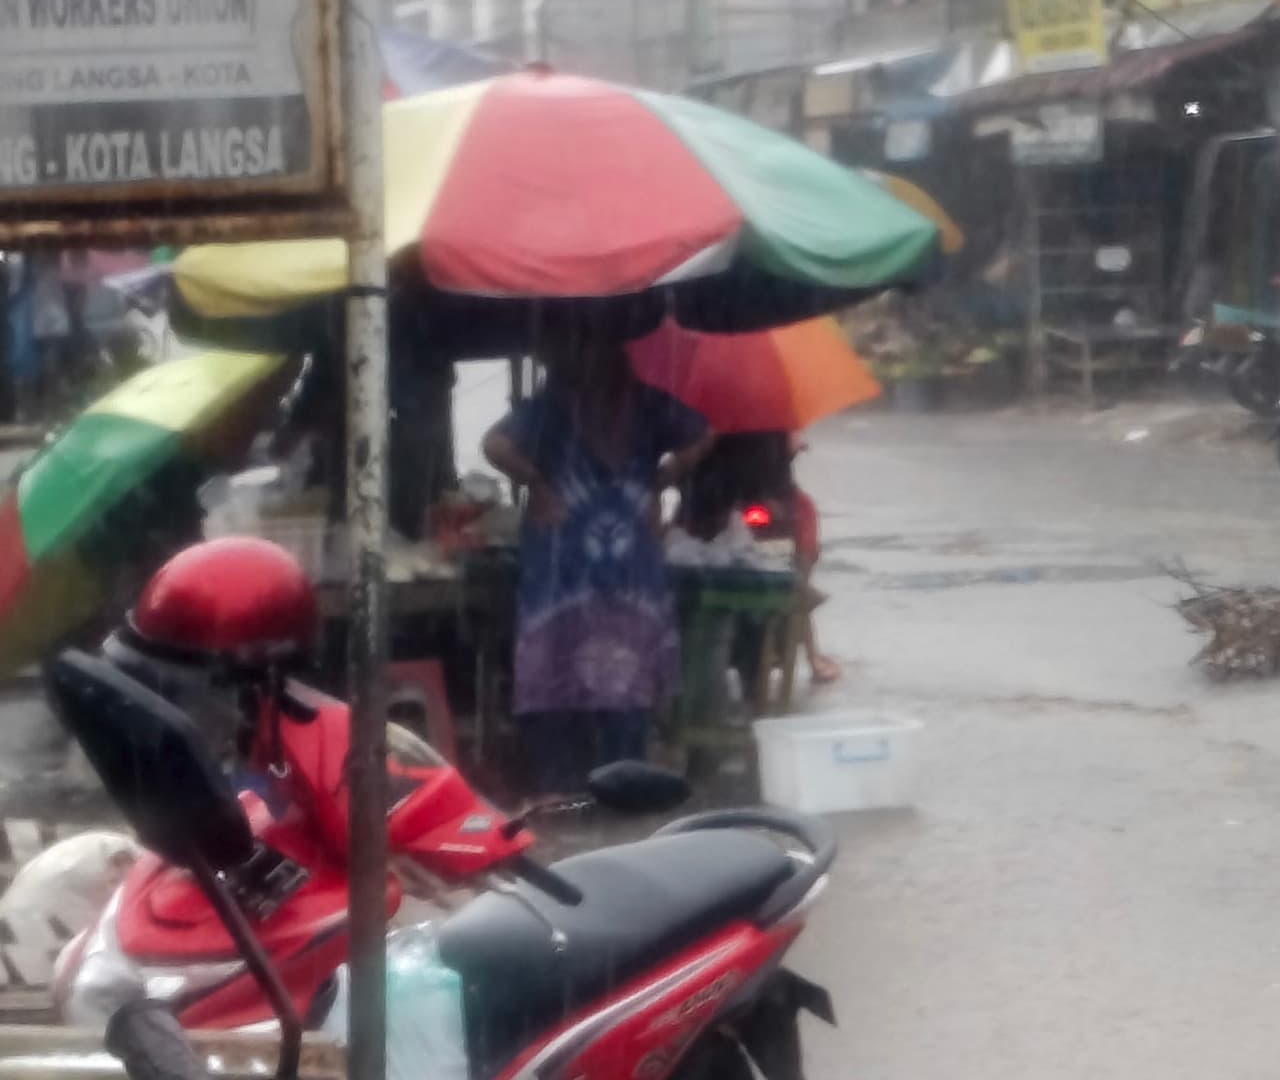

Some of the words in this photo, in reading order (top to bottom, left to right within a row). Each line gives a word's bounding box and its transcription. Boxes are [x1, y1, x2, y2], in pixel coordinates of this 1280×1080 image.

[53, 63, 162, 92] LANGSA
[182, 61, 252, 85] KOTA
[65, 130, 151, 180] KOTA
[159, 124, 284, 179] LANGSA
